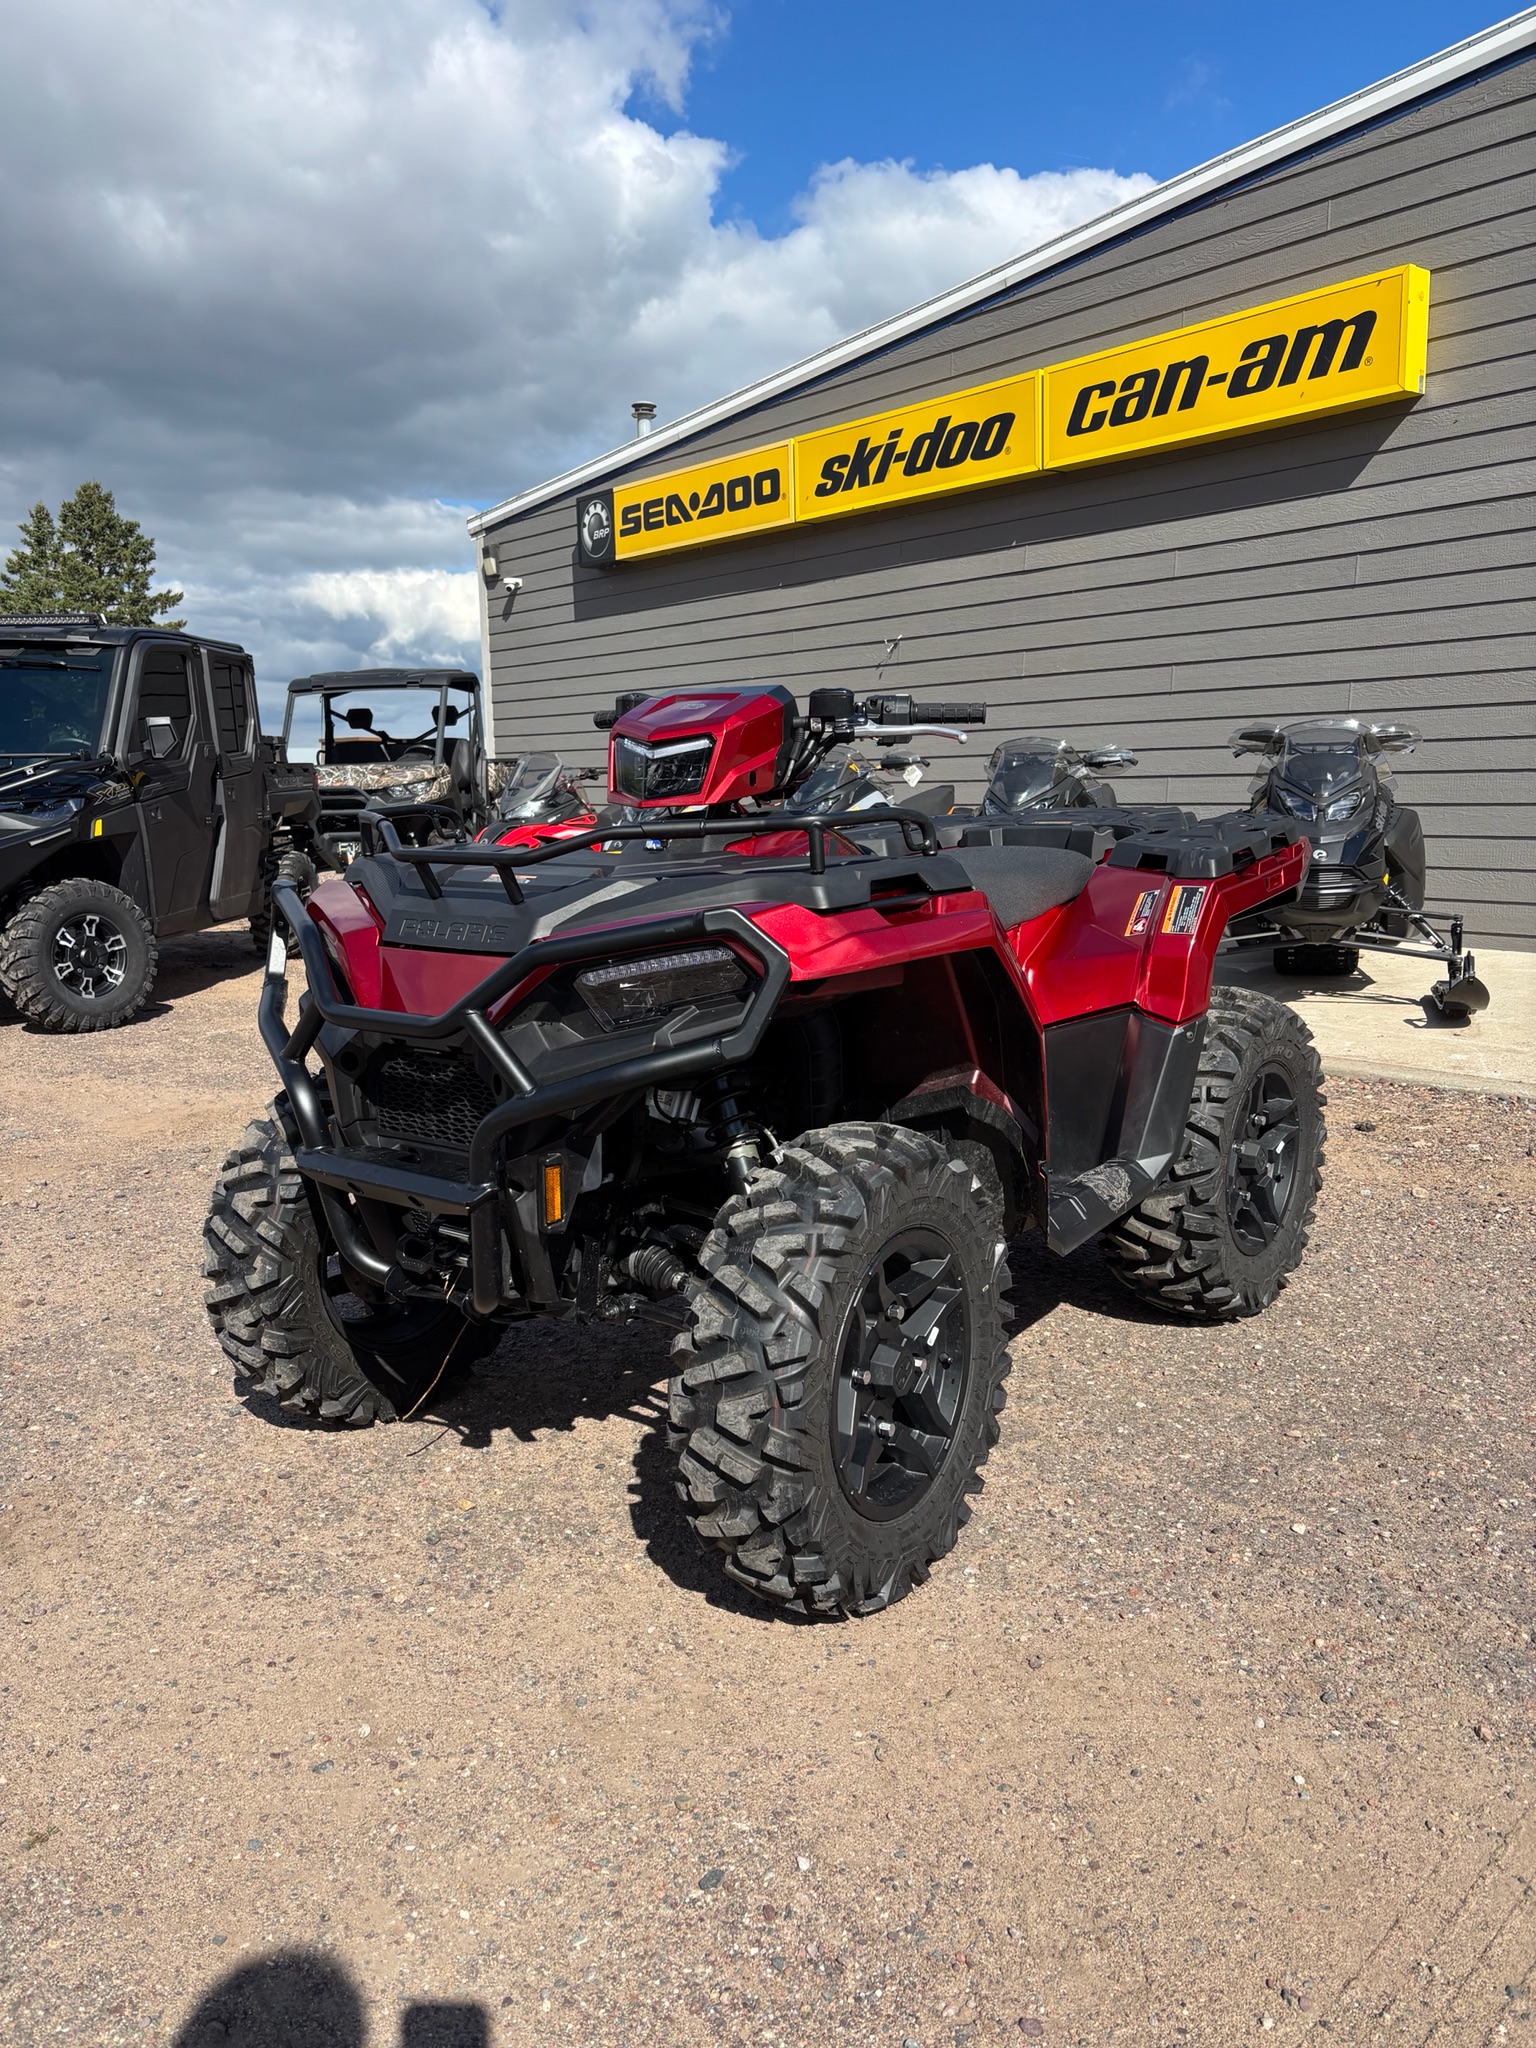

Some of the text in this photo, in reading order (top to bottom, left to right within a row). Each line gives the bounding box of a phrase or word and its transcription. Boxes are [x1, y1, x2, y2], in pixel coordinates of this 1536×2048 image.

[1067, 311, 1376, 436] can-am
[815, 413, 1016, 497] ski-doo
[593, 527, 610, 540] BRP
[399, 918, 510, 943] POLARIS
